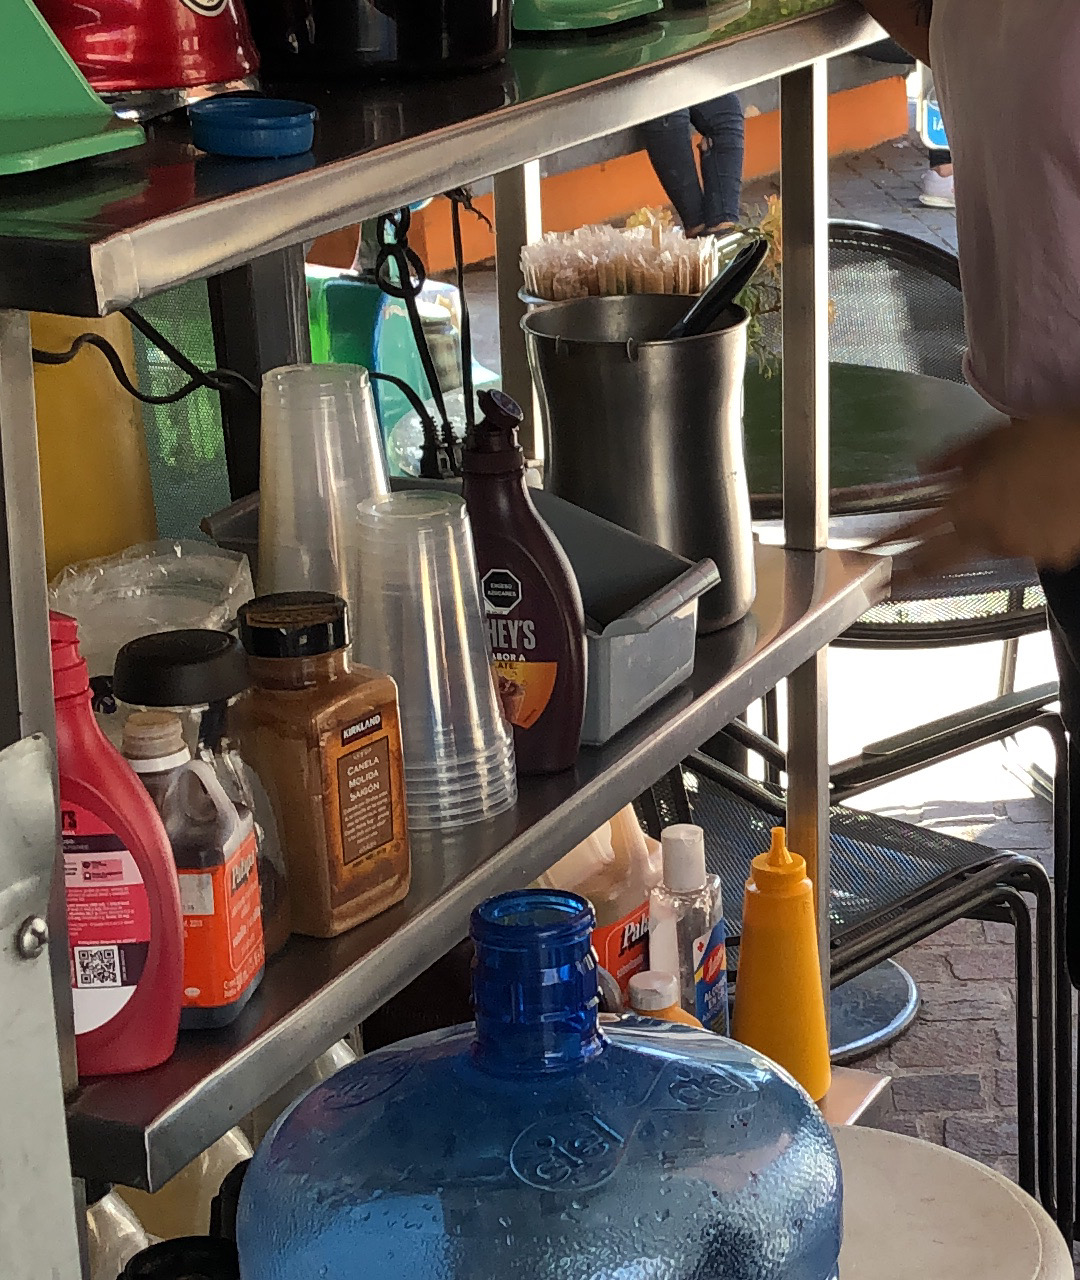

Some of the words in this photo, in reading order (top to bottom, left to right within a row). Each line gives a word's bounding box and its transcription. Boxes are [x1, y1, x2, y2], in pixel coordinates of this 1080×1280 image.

[343, 714, 381, 739] KIRKLAND
[347, 756, 380, 777] CANELA
[348, 769, 379, 789] MOLIDA
